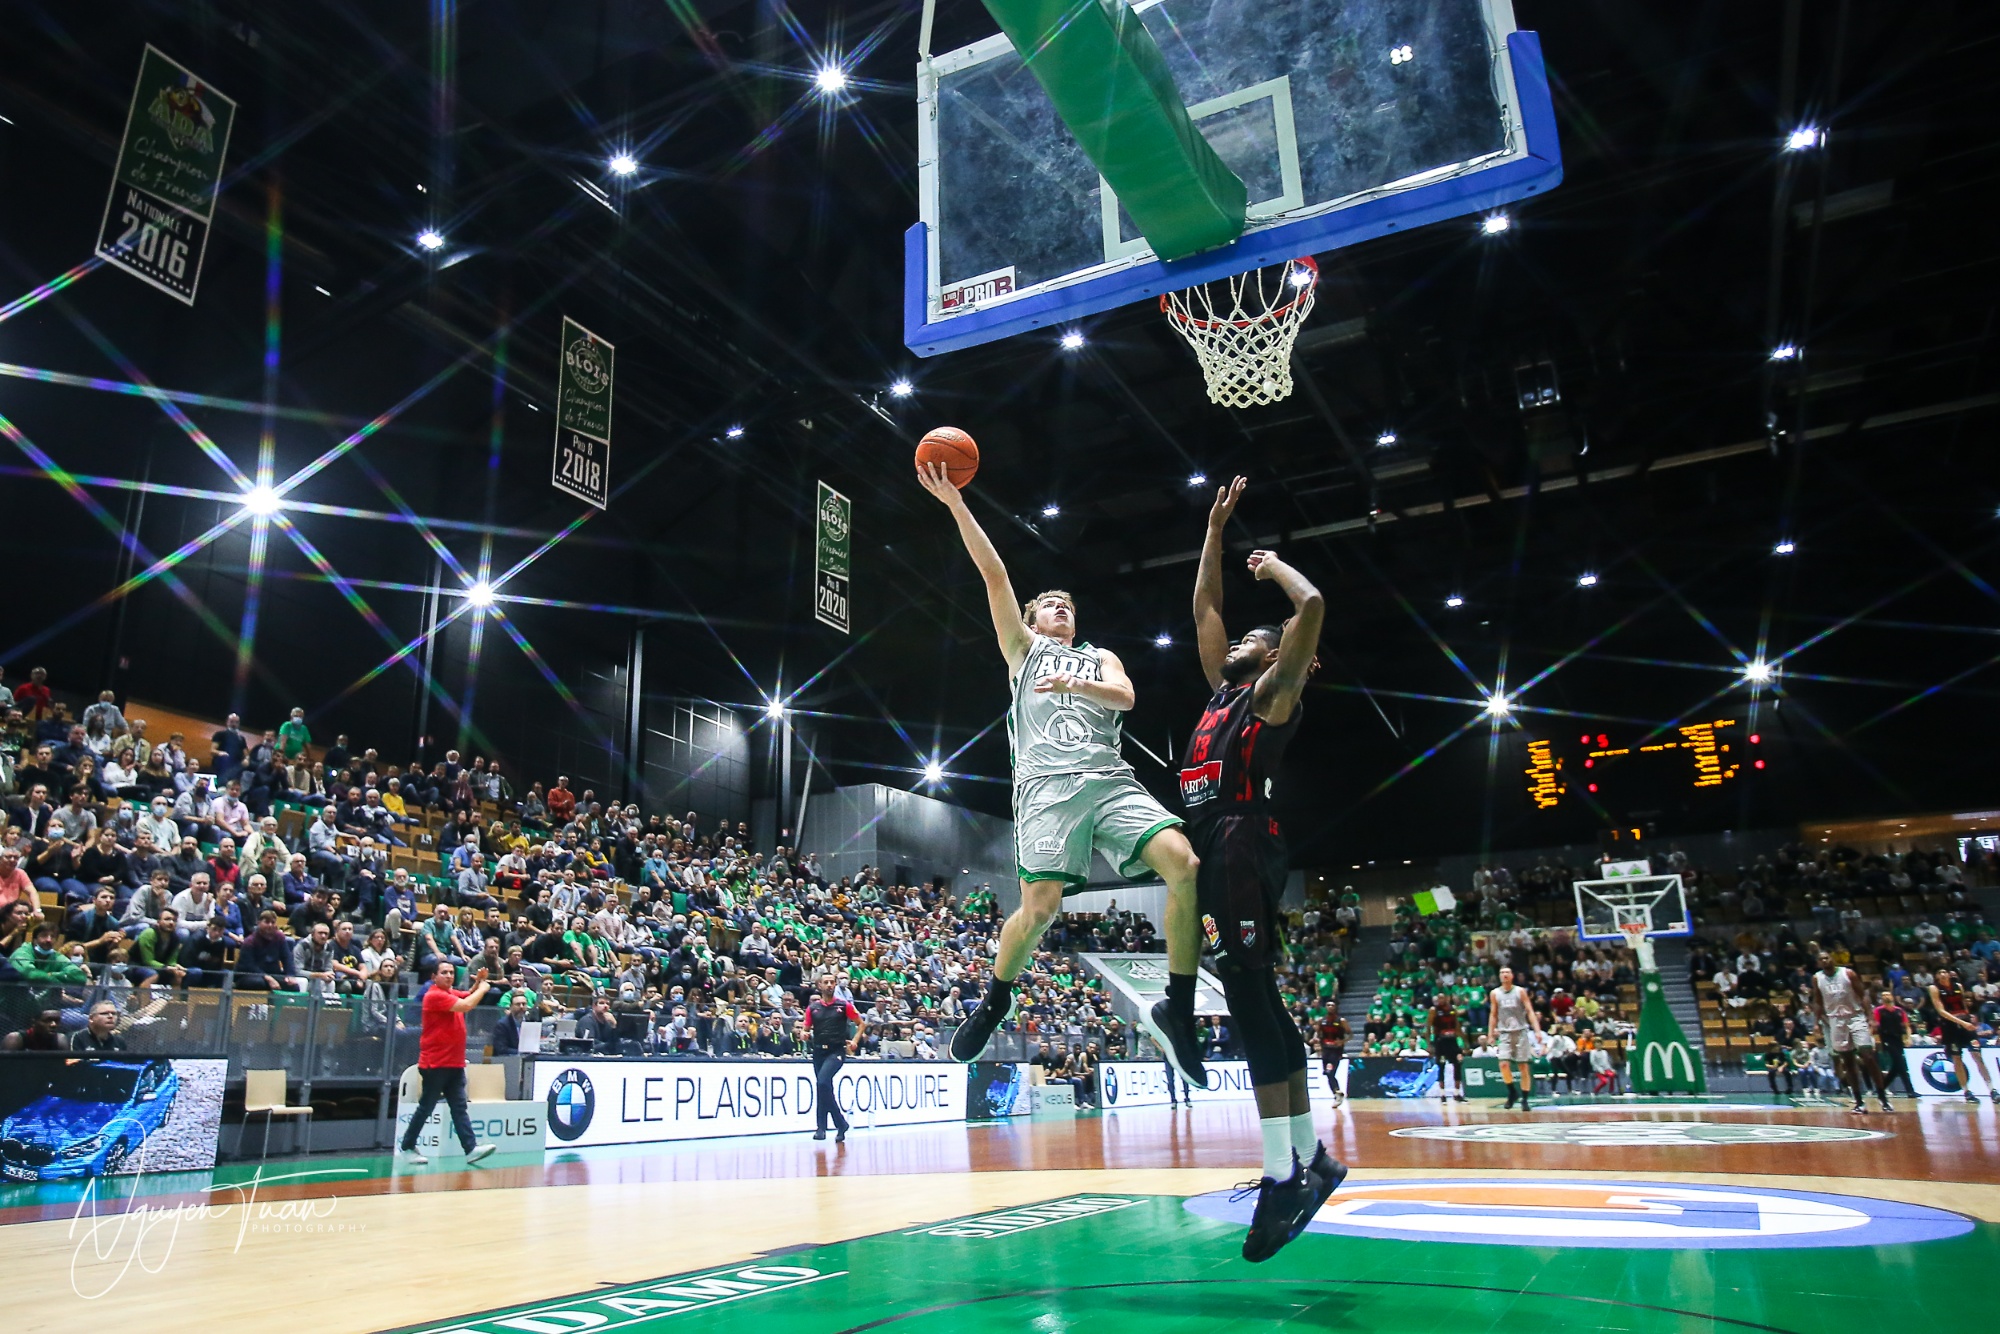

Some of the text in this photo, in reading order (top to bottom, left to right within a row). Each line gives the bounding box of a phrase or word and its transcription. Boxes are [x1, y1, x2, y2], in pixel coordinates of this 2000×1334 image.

[116, 210, 189, 280] 2016
[566, 350, 610, 387] BLOIS
[561, 447, 601, 492] 2018
[820, 508, 848, 535] BLOIS
[819, 585, 847, 620] 2020
[1034, 653, 1098, 681] ADA
[552, 1070, 592, 1094] BMW
[621, 1077, 664, 1123] LE
[675, 1076, 788, 1121] PLAISIR
[838, 1073, 950, 1113] CONDUIRE
[928, 1197, 1133, 1238] SIDAMO
